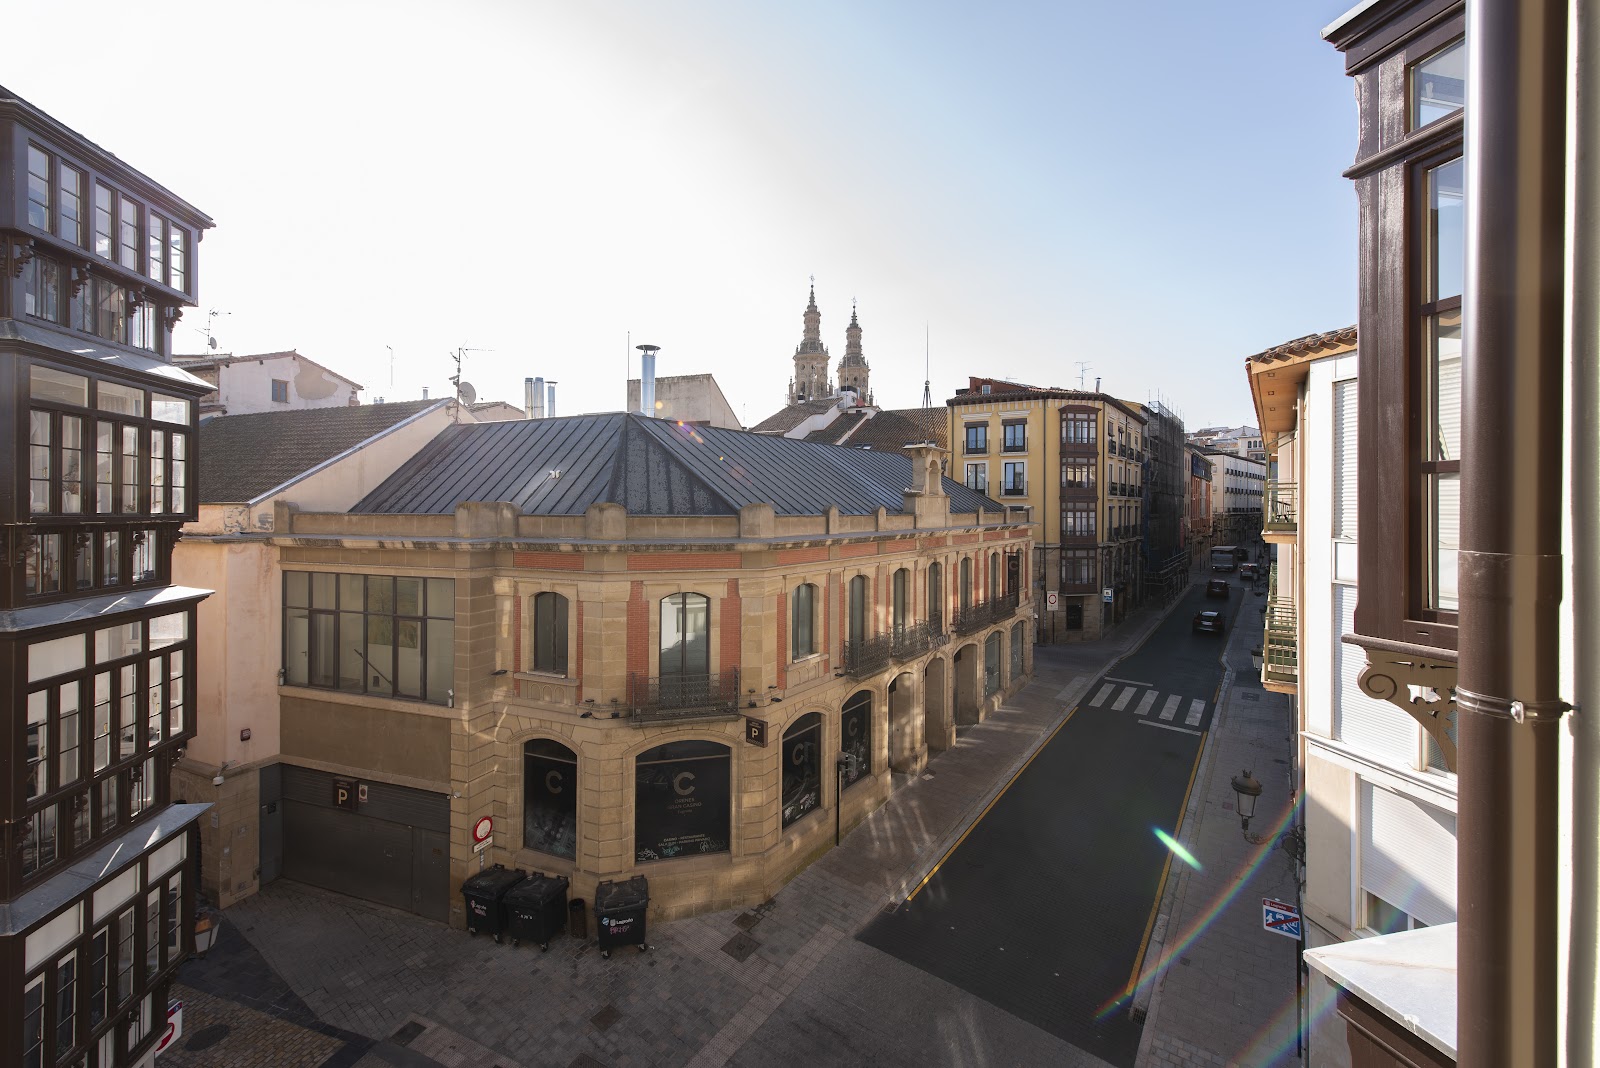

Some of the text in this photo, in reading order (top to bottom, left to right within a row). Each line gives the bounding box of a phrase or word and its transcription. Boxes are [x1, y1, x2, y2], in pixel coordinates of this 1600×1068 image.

[751, 727, 759, 739] P
[545, 770, 563, 794] C
[673, 771, 696, 796] C
[338, 788, 348, 805] P
